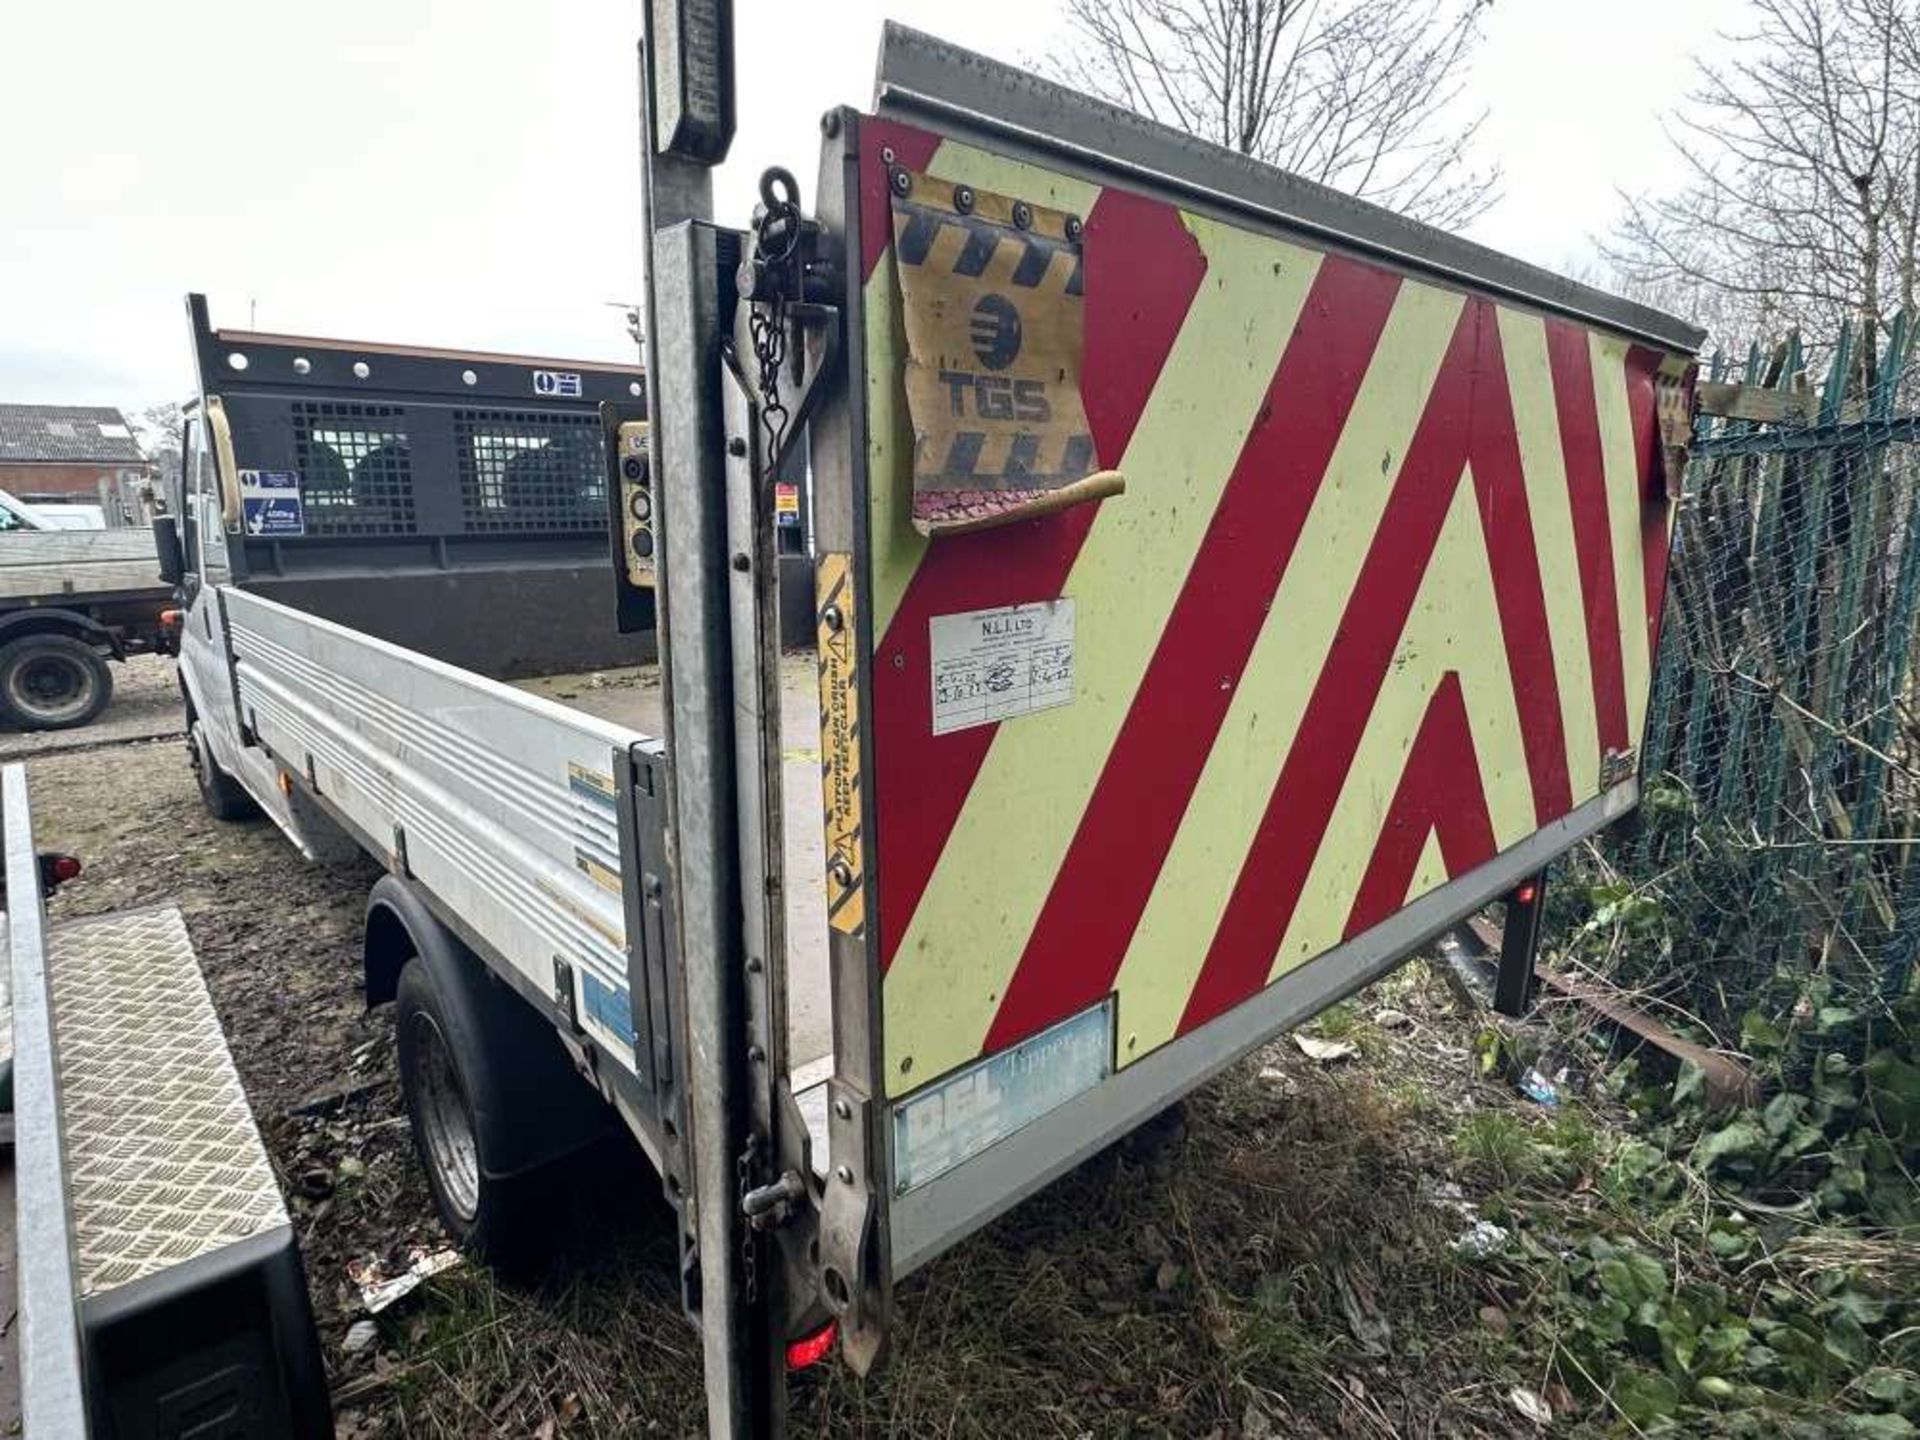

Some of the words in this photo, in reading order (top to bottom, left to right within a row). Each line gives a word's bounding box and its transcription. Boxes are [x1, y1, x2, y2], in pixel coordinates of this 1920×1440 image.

[938, 370, 1049, 421] TGS
[829, 658, 840, 714] CRUSH
[838, 678, 848, 732] CLEAR
[831, 716, 841, 751] CAN
[840, 736, 850, 774] FEET
[833, 752, 844, 833] PLATFORM
[841, 776, 851, 818] KEEP
